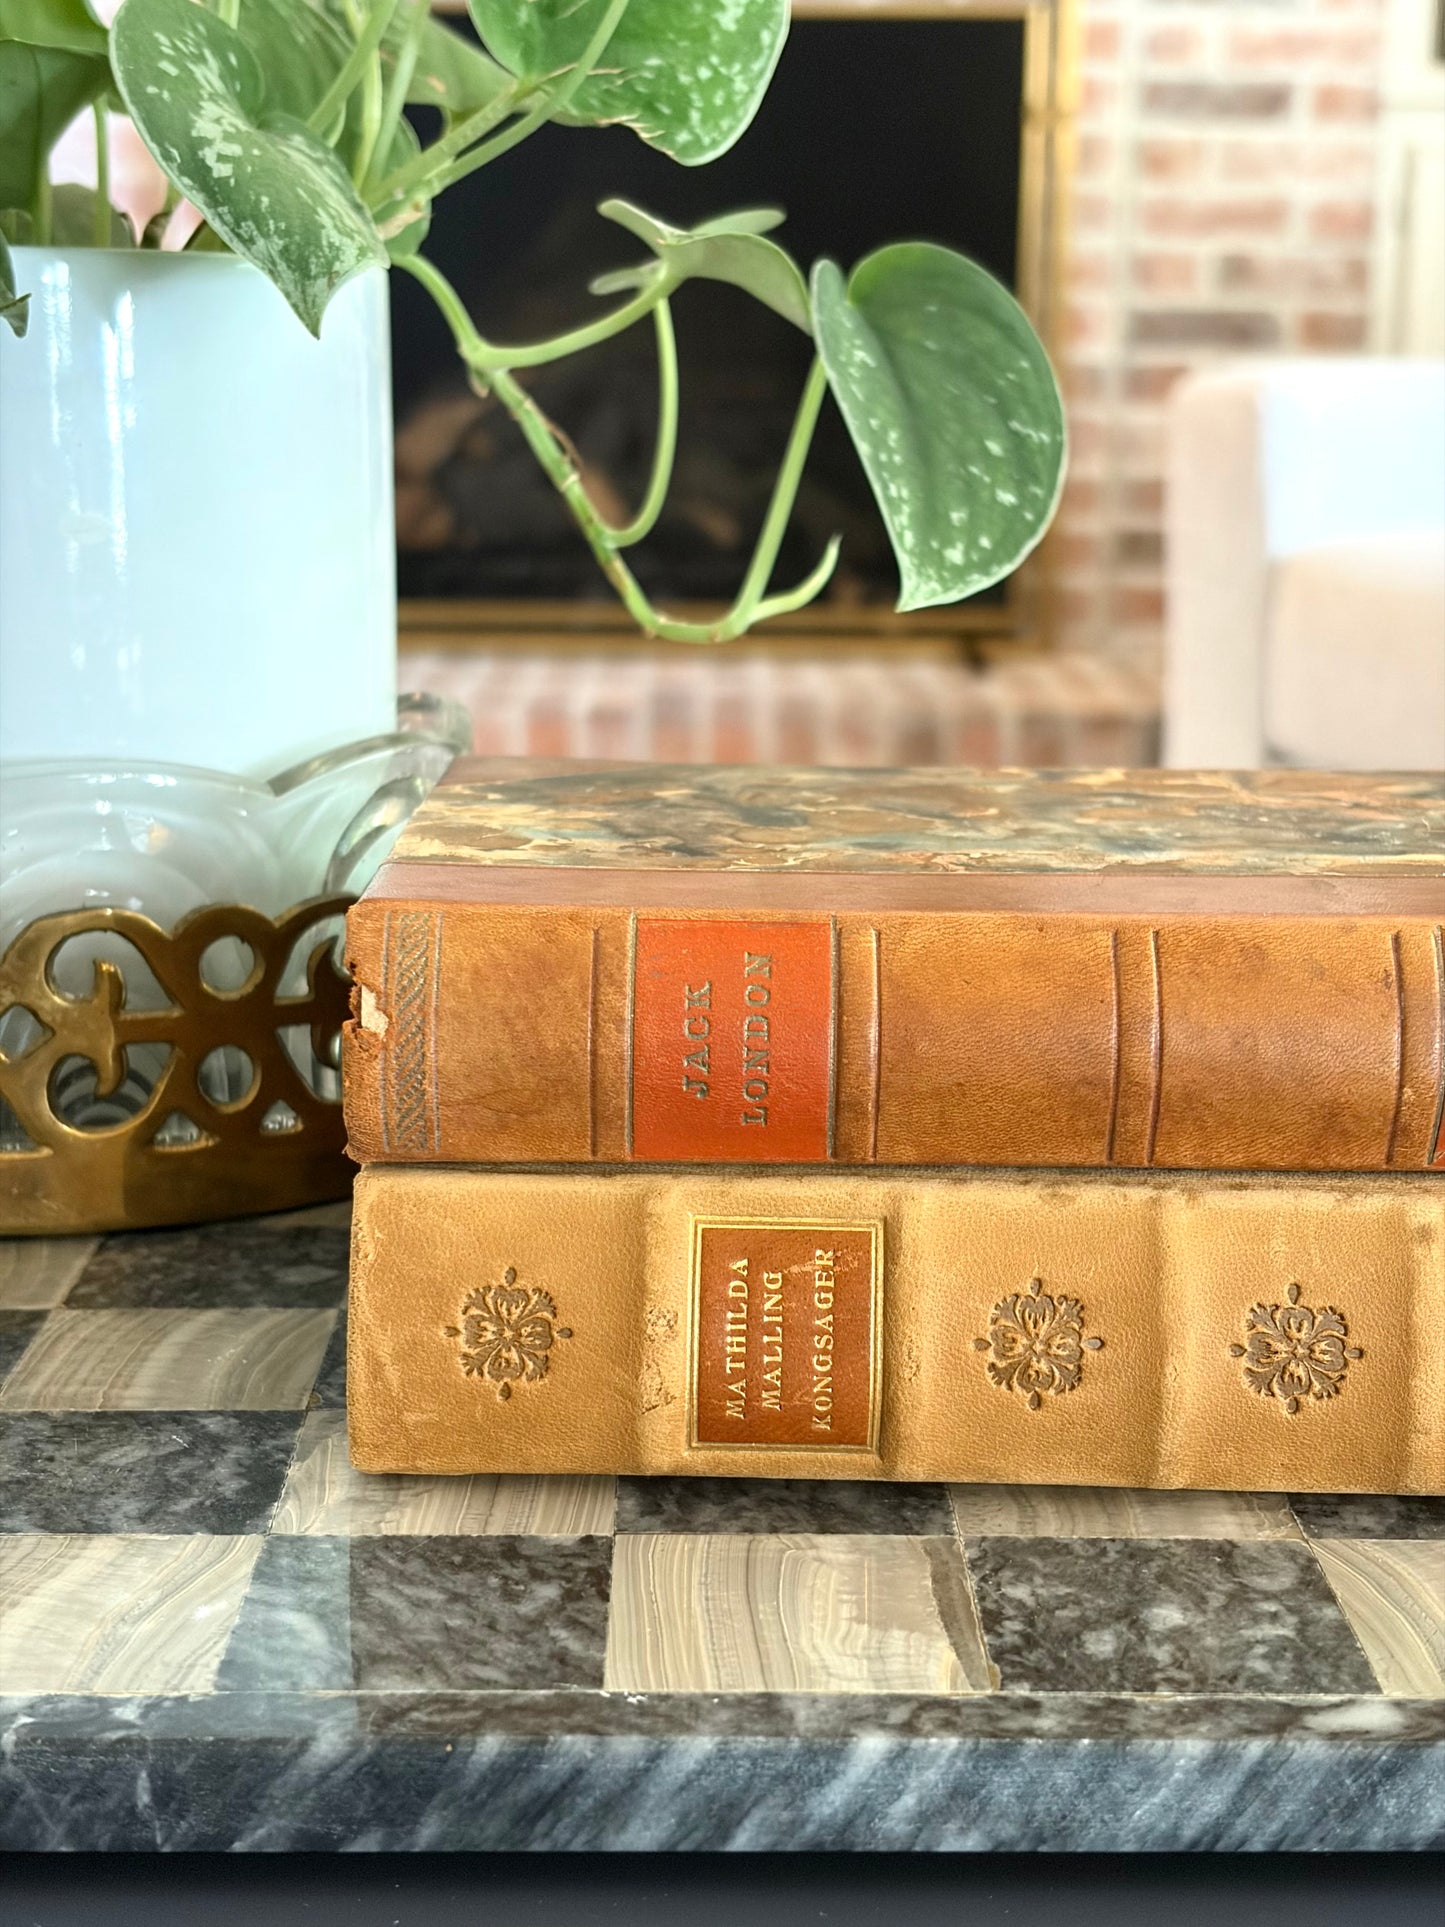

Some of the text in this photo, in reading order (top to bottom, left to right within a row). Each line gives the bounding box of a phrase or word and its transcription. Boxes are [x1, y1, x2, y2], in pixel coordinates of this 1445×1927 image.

[682, 980, 711, 1100] JACK
[741, 951, 772, 1128] LONDON
[725, 1257, 749, 1420] MATHILDA
[761, 1270, 784, 1412] MALLING
[811, 1248, 835, 1431] KONGSAGER
